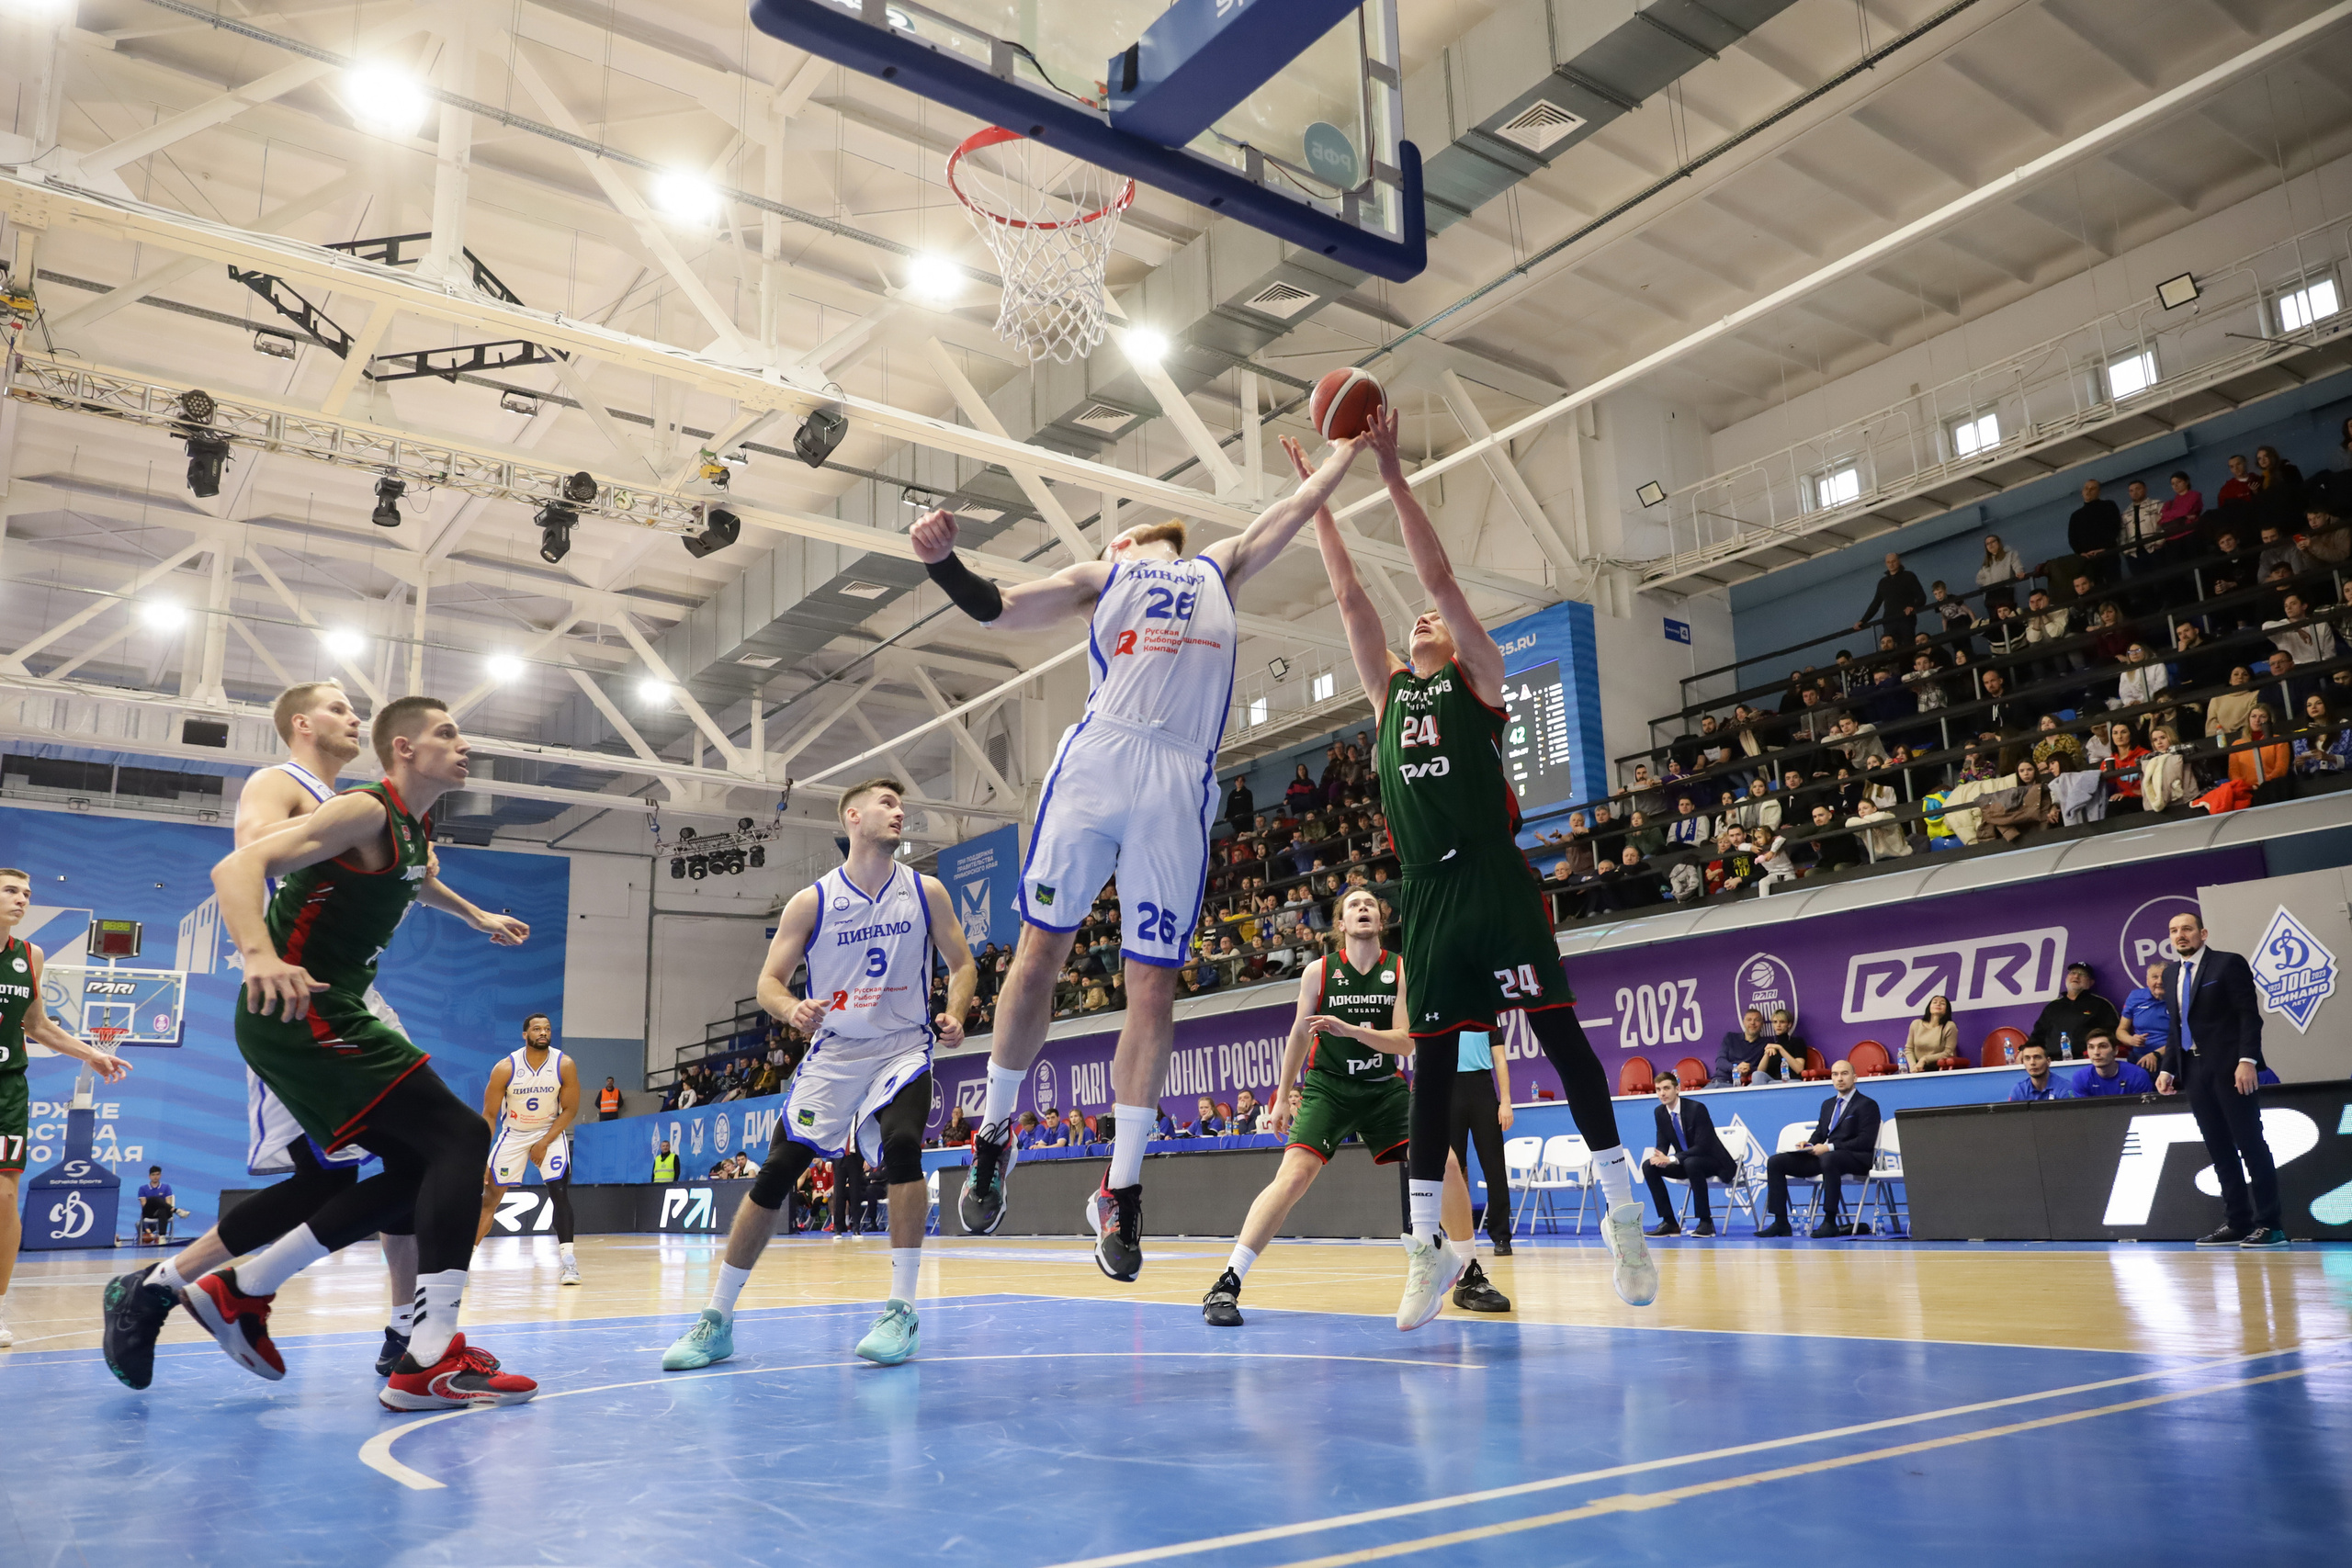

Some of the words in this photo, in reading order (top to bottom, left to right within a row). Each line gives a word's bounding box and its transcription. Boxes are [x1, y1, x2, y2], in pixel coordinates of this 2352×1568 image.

[1146, 587, 1196, 620] 26
[1144, 636, 1221, 649] Рыбопрошленная
[1145, 627, 1180, 636] Русская
[1143, 645, 1178, 655] Компан
[1401, 715, 1442, 749] 24
[1509, 726, 1526, 745] 42
[837, 920, 911, 946] ДИНАМО
[1137, 901, 1178, 944] 26
[865, 947, 888, 977] 3
[1494, 964, 1543, 999] 24
[1850, 937, 2055, 1013] PARI
[85, 981, 136, 995] PARI
[1754, 990, 1777, 1000] PARI
[2270, 982, 2328, 1007] ДИНАМО
[513, 1086, 555, 1095] ДИНАМО
[1071, 1061, 1106, 1106] PARI
[526, 1098, 539, 1111] 6
[550, 1156, 563, 1170] 6
